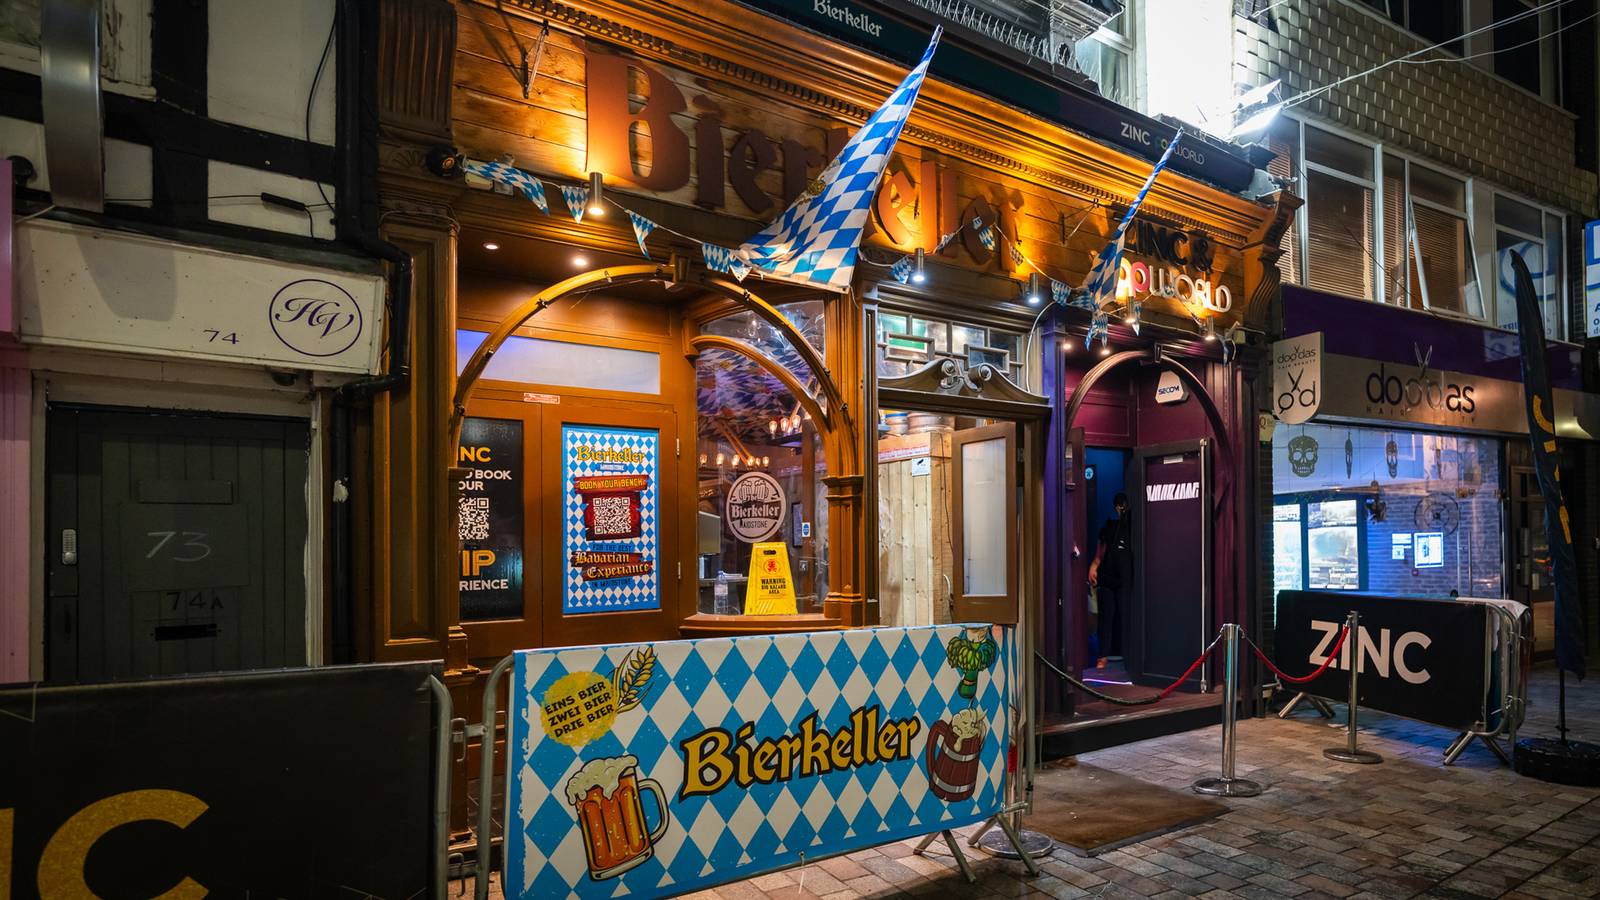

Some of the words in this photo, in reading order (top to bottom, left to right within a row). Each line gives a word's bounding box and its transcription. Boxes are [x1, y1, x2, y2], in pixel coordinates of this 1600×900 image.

[813, 0, 882, 37] Bierkeller
[1120, 121, 1151, 146] ZINC
[585, 51, 1025, 272] Biereller
[1191, 229, 1214, 275] &
[203, 329, 240, 345] 74
[1158, 385, 1181, 395] SECOM
[576, 445, 645, 463] Bierkeller
[475, 469, 512, 480] BOOK
[579, 481, 597, 490] BOOK
[600, 480, 618, 488] YOUR
[621, 477, 643, 487] BENCH
[731, 503, 780, 518] Bierkeller
[145, 531, 211, 562] 73
[574, 551, 630, 565] Bavarian
[761, 577, 786, 585] WARNING
[167, 591, 224, 611] 74A
[1309, 619, 1432, 684] ZINC
[544, 695, 576, 716] EINS
[577, 680, 607, 701] BIER
[548, 705, 582, 727] ZWEI
[583, 692, 612, 712] BIER
[554, 717, 585, 738] DRIE
[586, 703, 615, 723] BIER
[679, 704, 921, 803] Bierkeller
